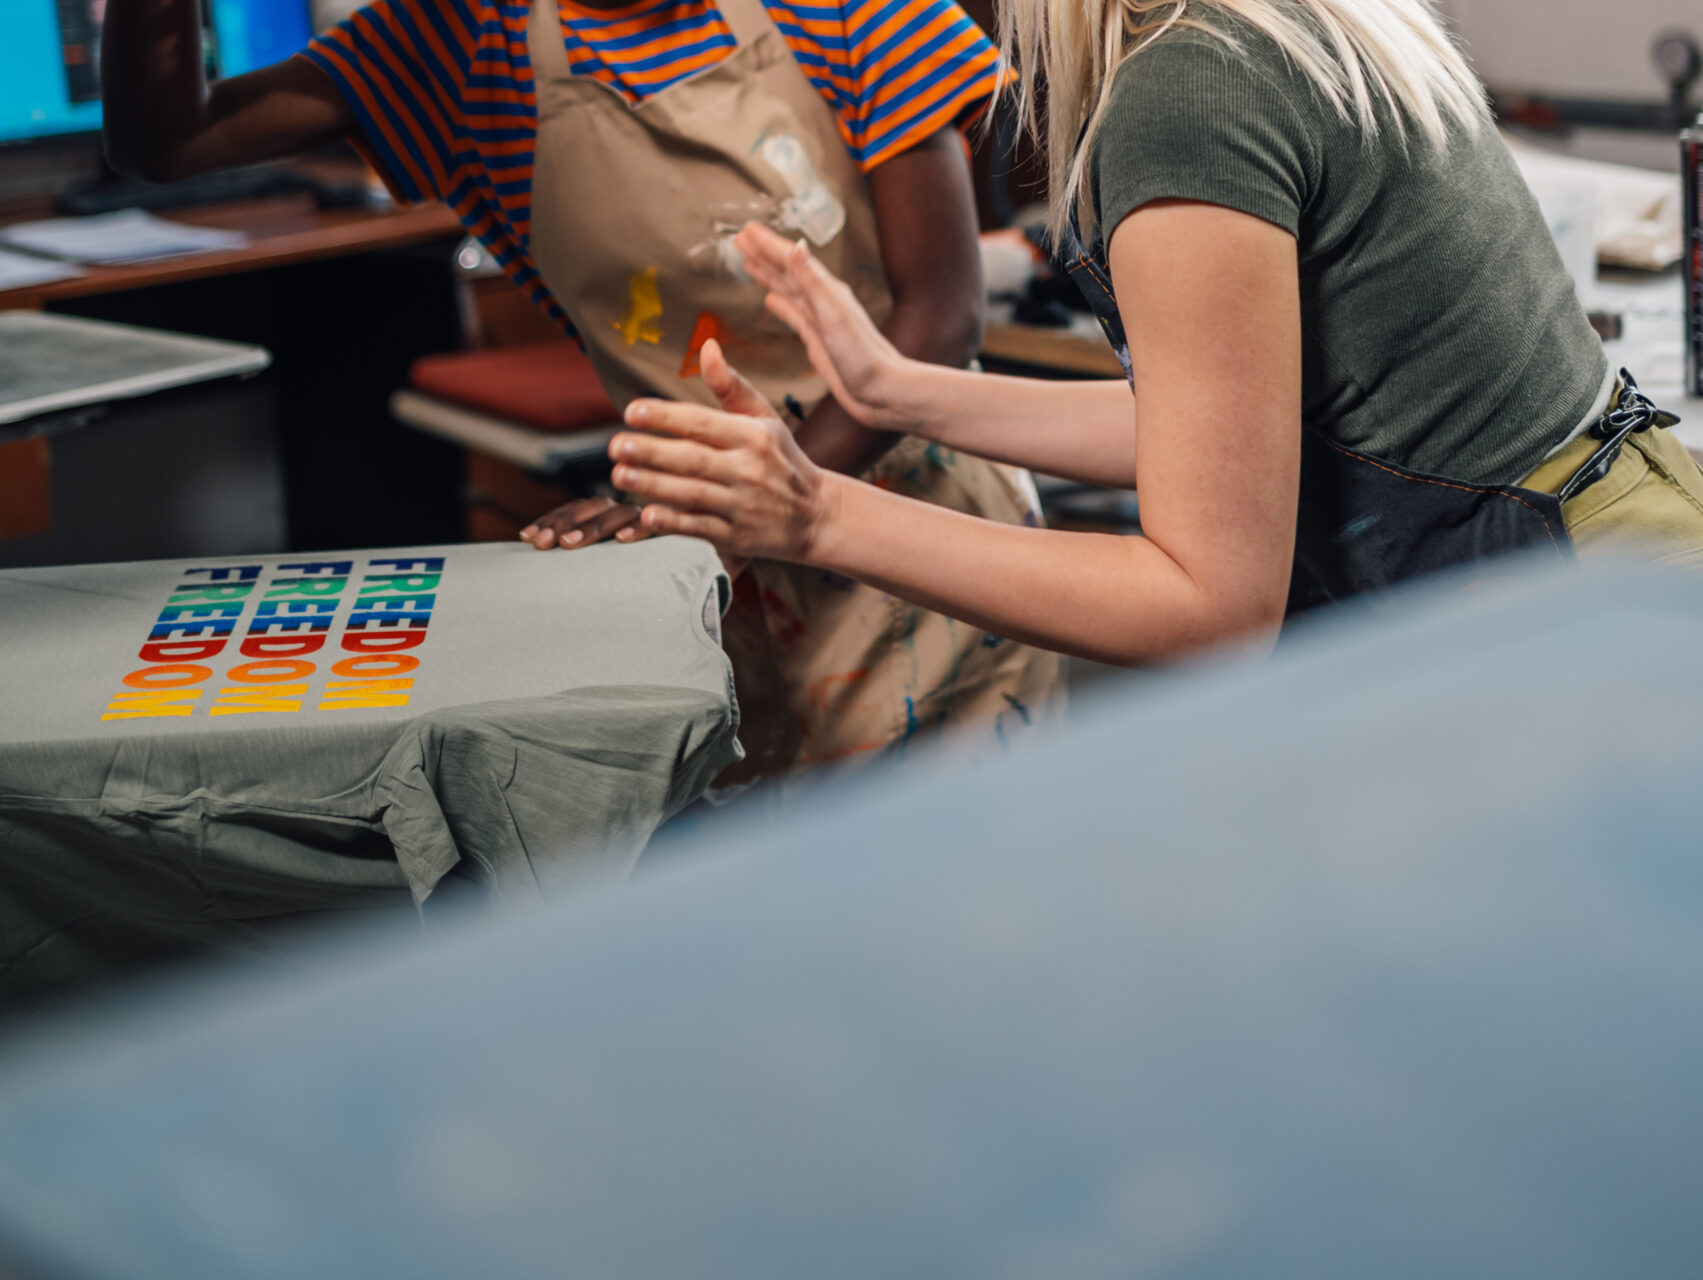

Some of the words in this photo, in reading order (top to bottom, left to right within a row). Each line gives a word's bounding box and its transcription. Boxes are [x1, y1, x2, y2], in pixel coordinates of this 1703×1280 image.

[101, 565, 262, 721] FREEDOM
[209, 560, 353, 716] FREEDOM
[318, 557, 446, 711] FREEDOM
